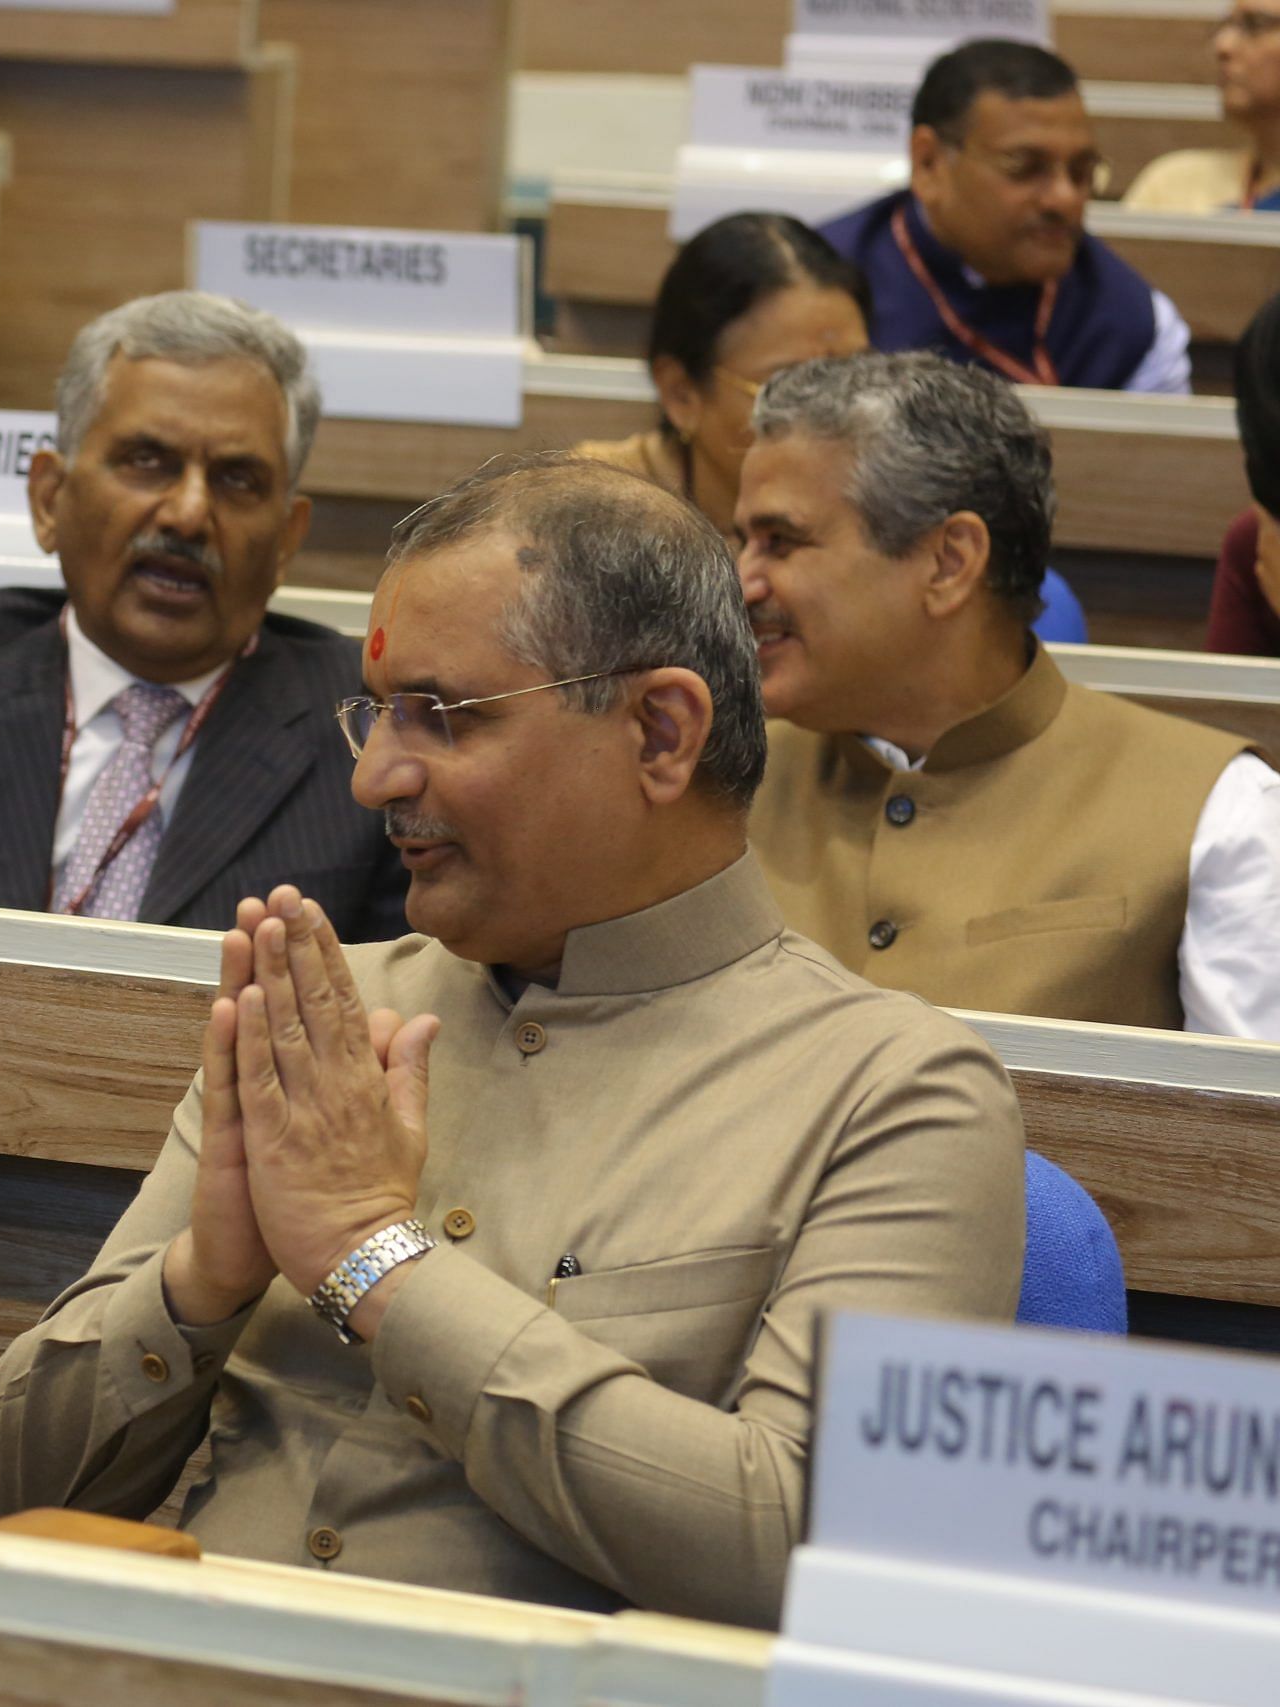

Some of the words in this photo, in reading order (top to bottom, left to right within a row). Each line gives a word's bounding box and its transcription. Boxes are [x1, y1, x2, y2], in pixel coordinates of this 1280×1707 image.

[244, 232, 447, 286] SECRETARIES
[860, 1363, 1103, 1475] JUSTICE
[1117, 1393, 1280, 1501] ARUN
